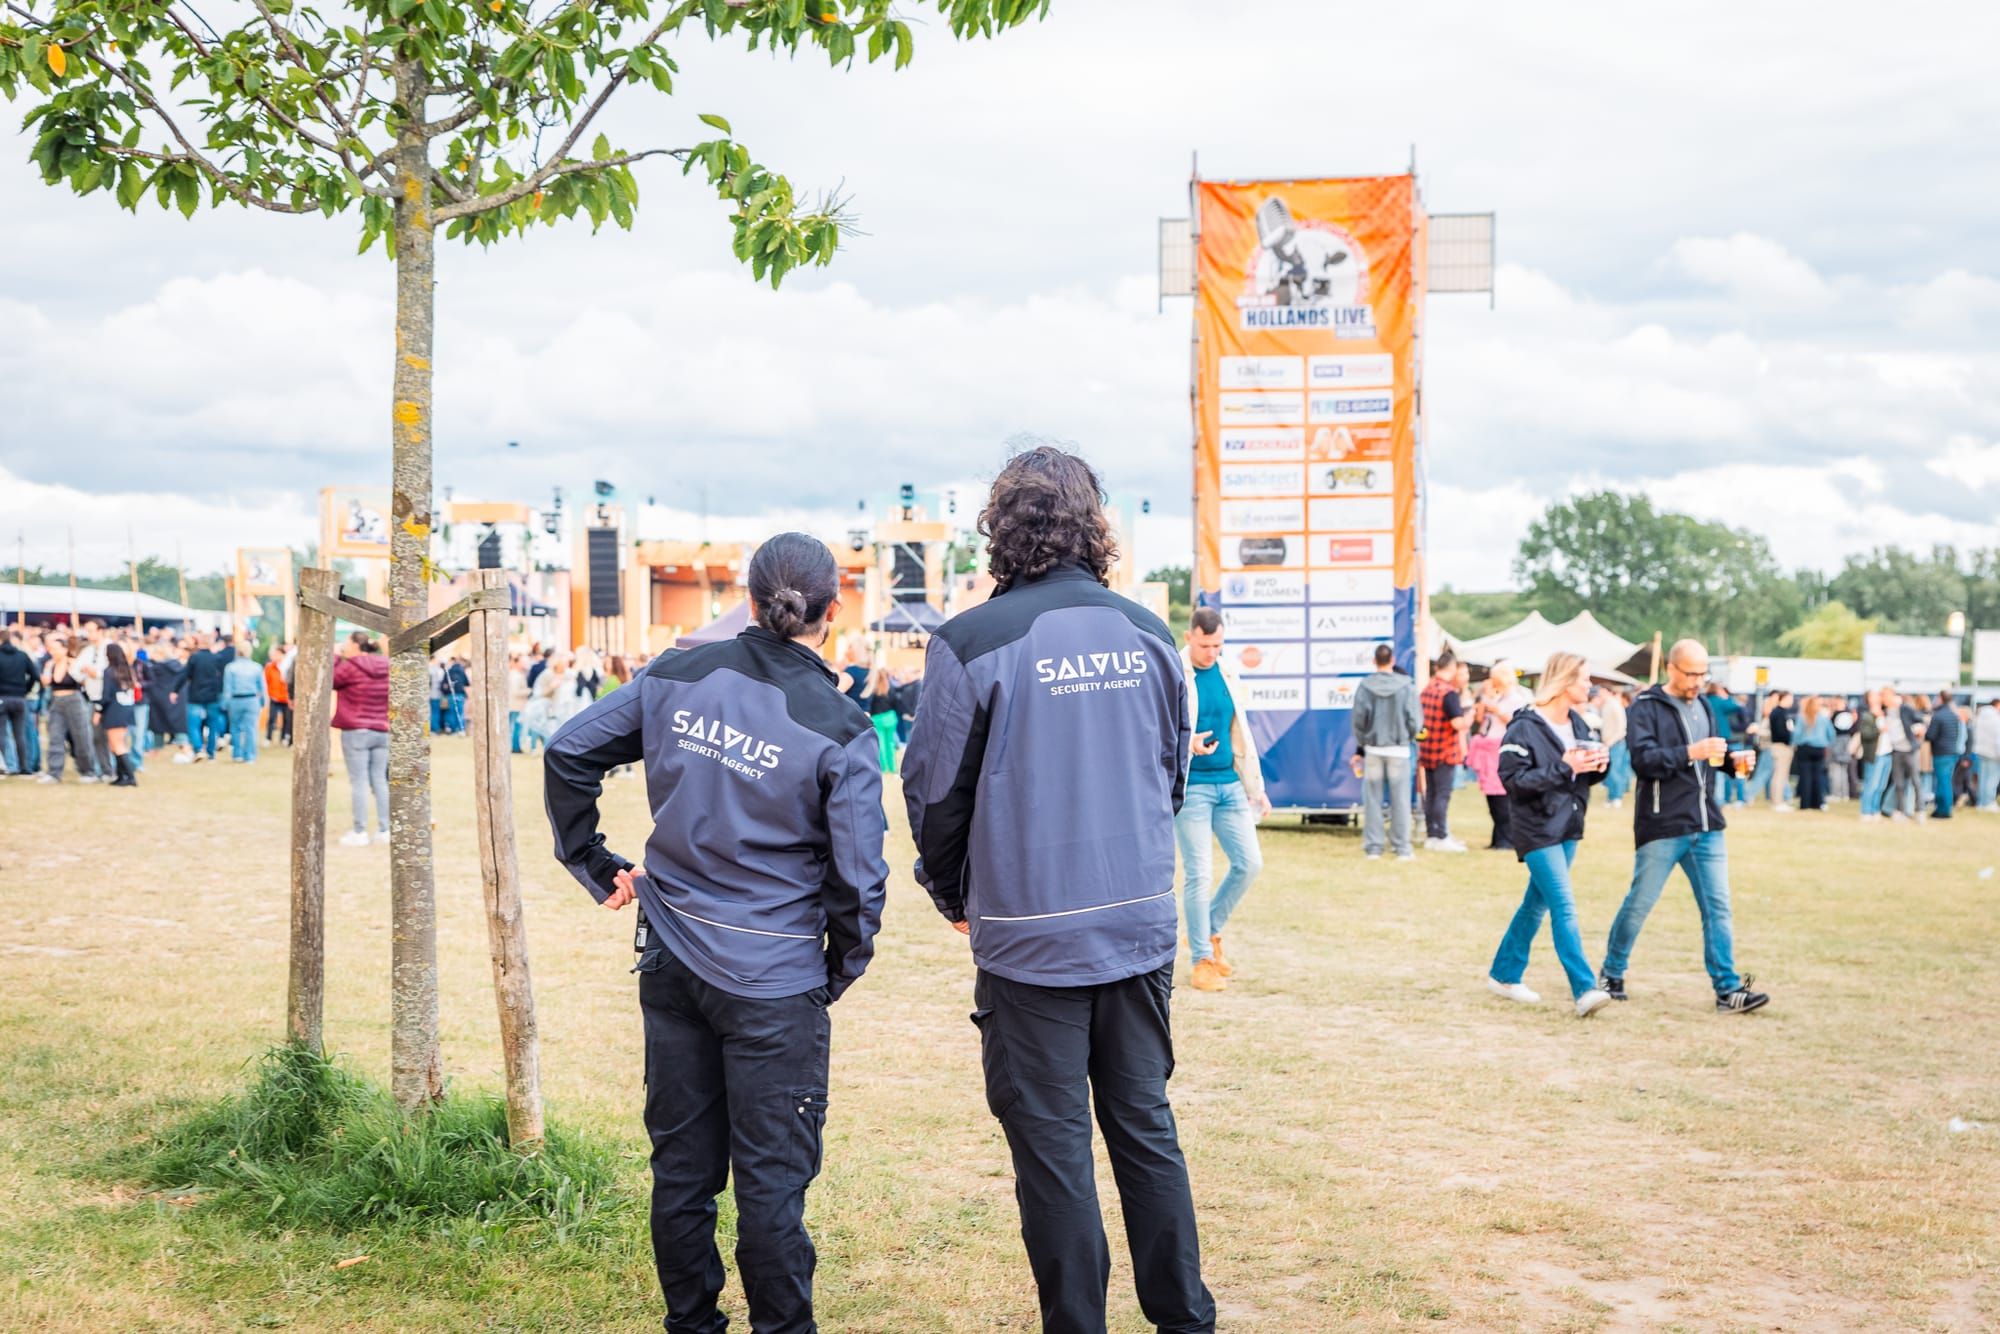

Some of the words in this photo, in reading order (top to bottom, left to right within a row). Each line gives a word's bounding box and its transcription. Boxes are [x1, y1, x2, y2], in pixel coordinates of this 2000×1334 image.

[1247, 308, 1329, 326] HOLLANDS
[1335, 308, 1366, 325] LIVE
[1253, 588, 1301, 598] BLUMEN
[1036, 651, 1147, 683] SALVUS
[1051, 682, 1101, 696] SECURITY
[1104, 679, 1142, 690] AGENCY
[1252, 690, 1299, 700] MEIJER
[672, 710, 784, 769] SALVUS
[720, 756, 765, 780] AGENCY
